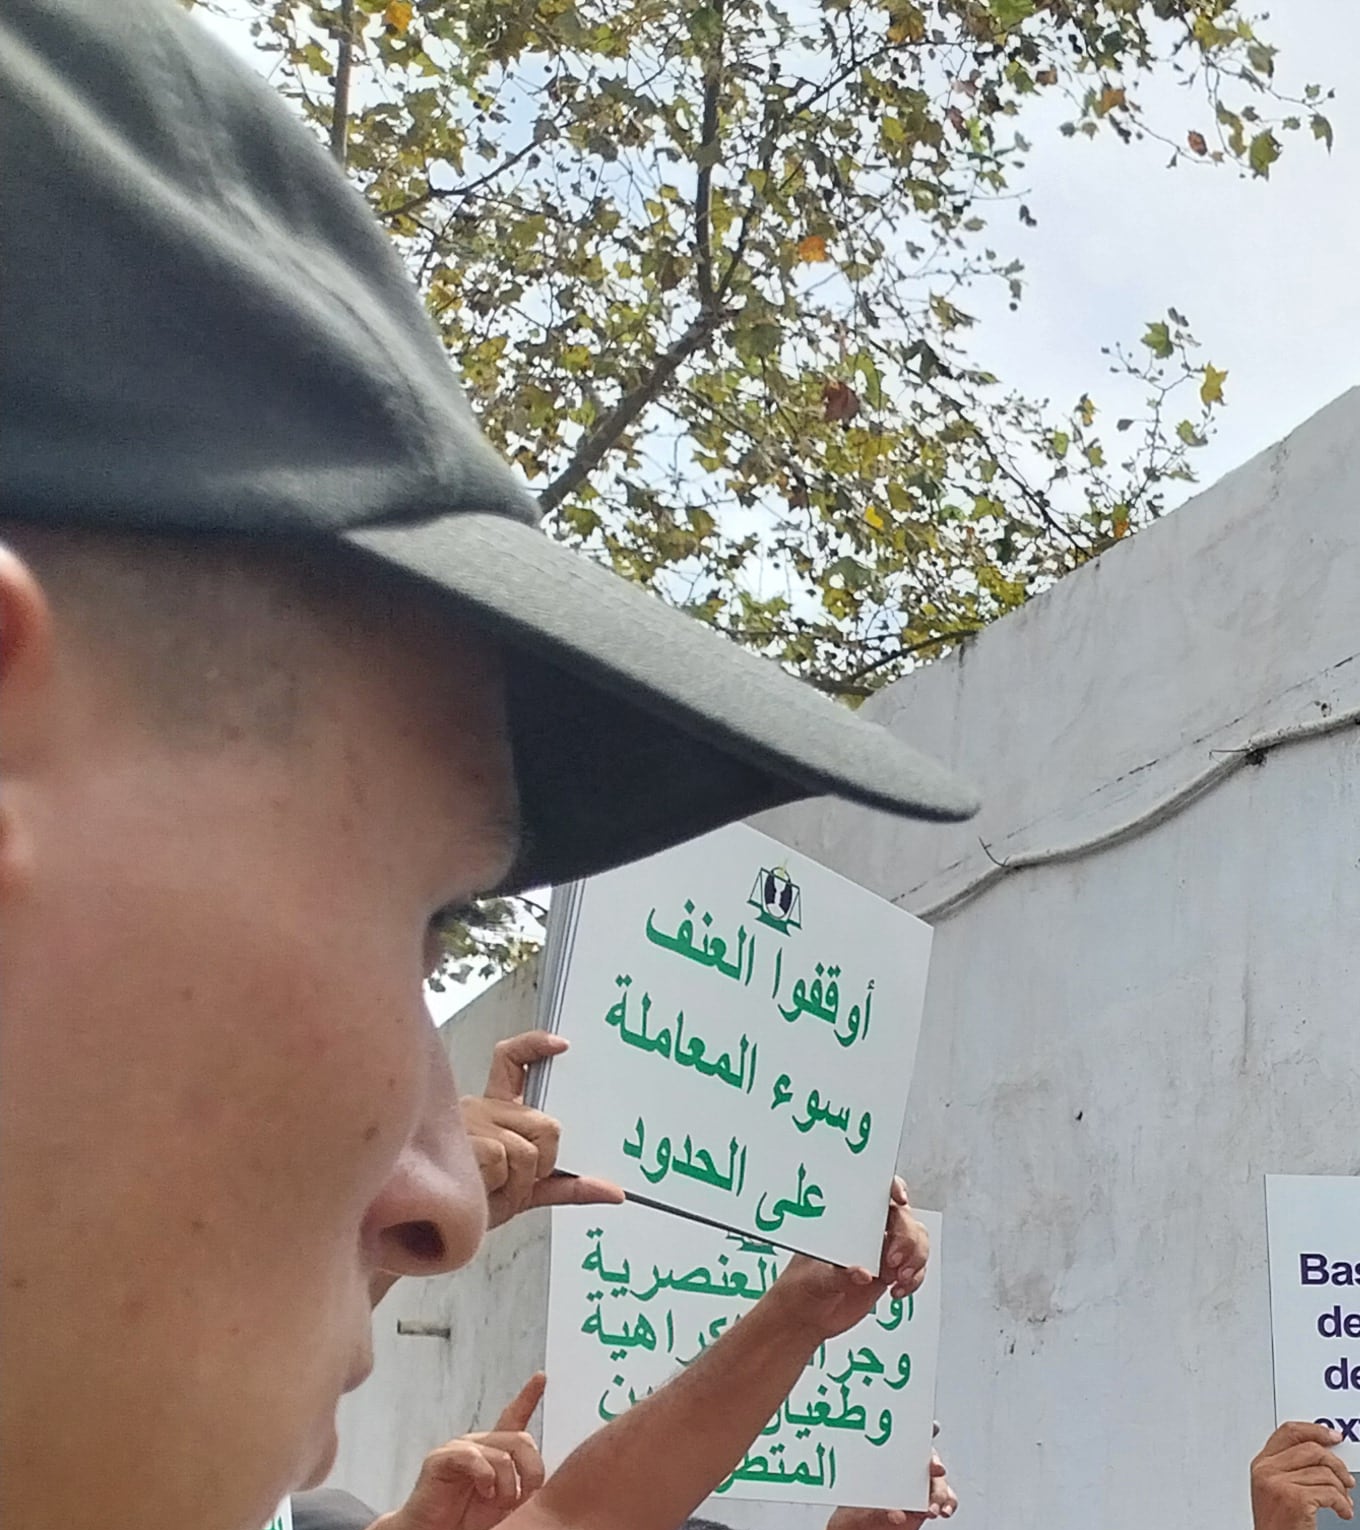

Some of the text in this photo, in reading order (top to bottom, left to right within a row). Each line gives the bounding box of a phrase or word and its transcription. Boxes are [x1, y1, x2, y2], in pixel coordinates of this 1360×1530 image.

[645, 899, 872, 1048] أوقفوا العنف
[604, 975, 872, 1155] وسوء المعاملة
[622, 1119, 826, 1233] على الحدود
